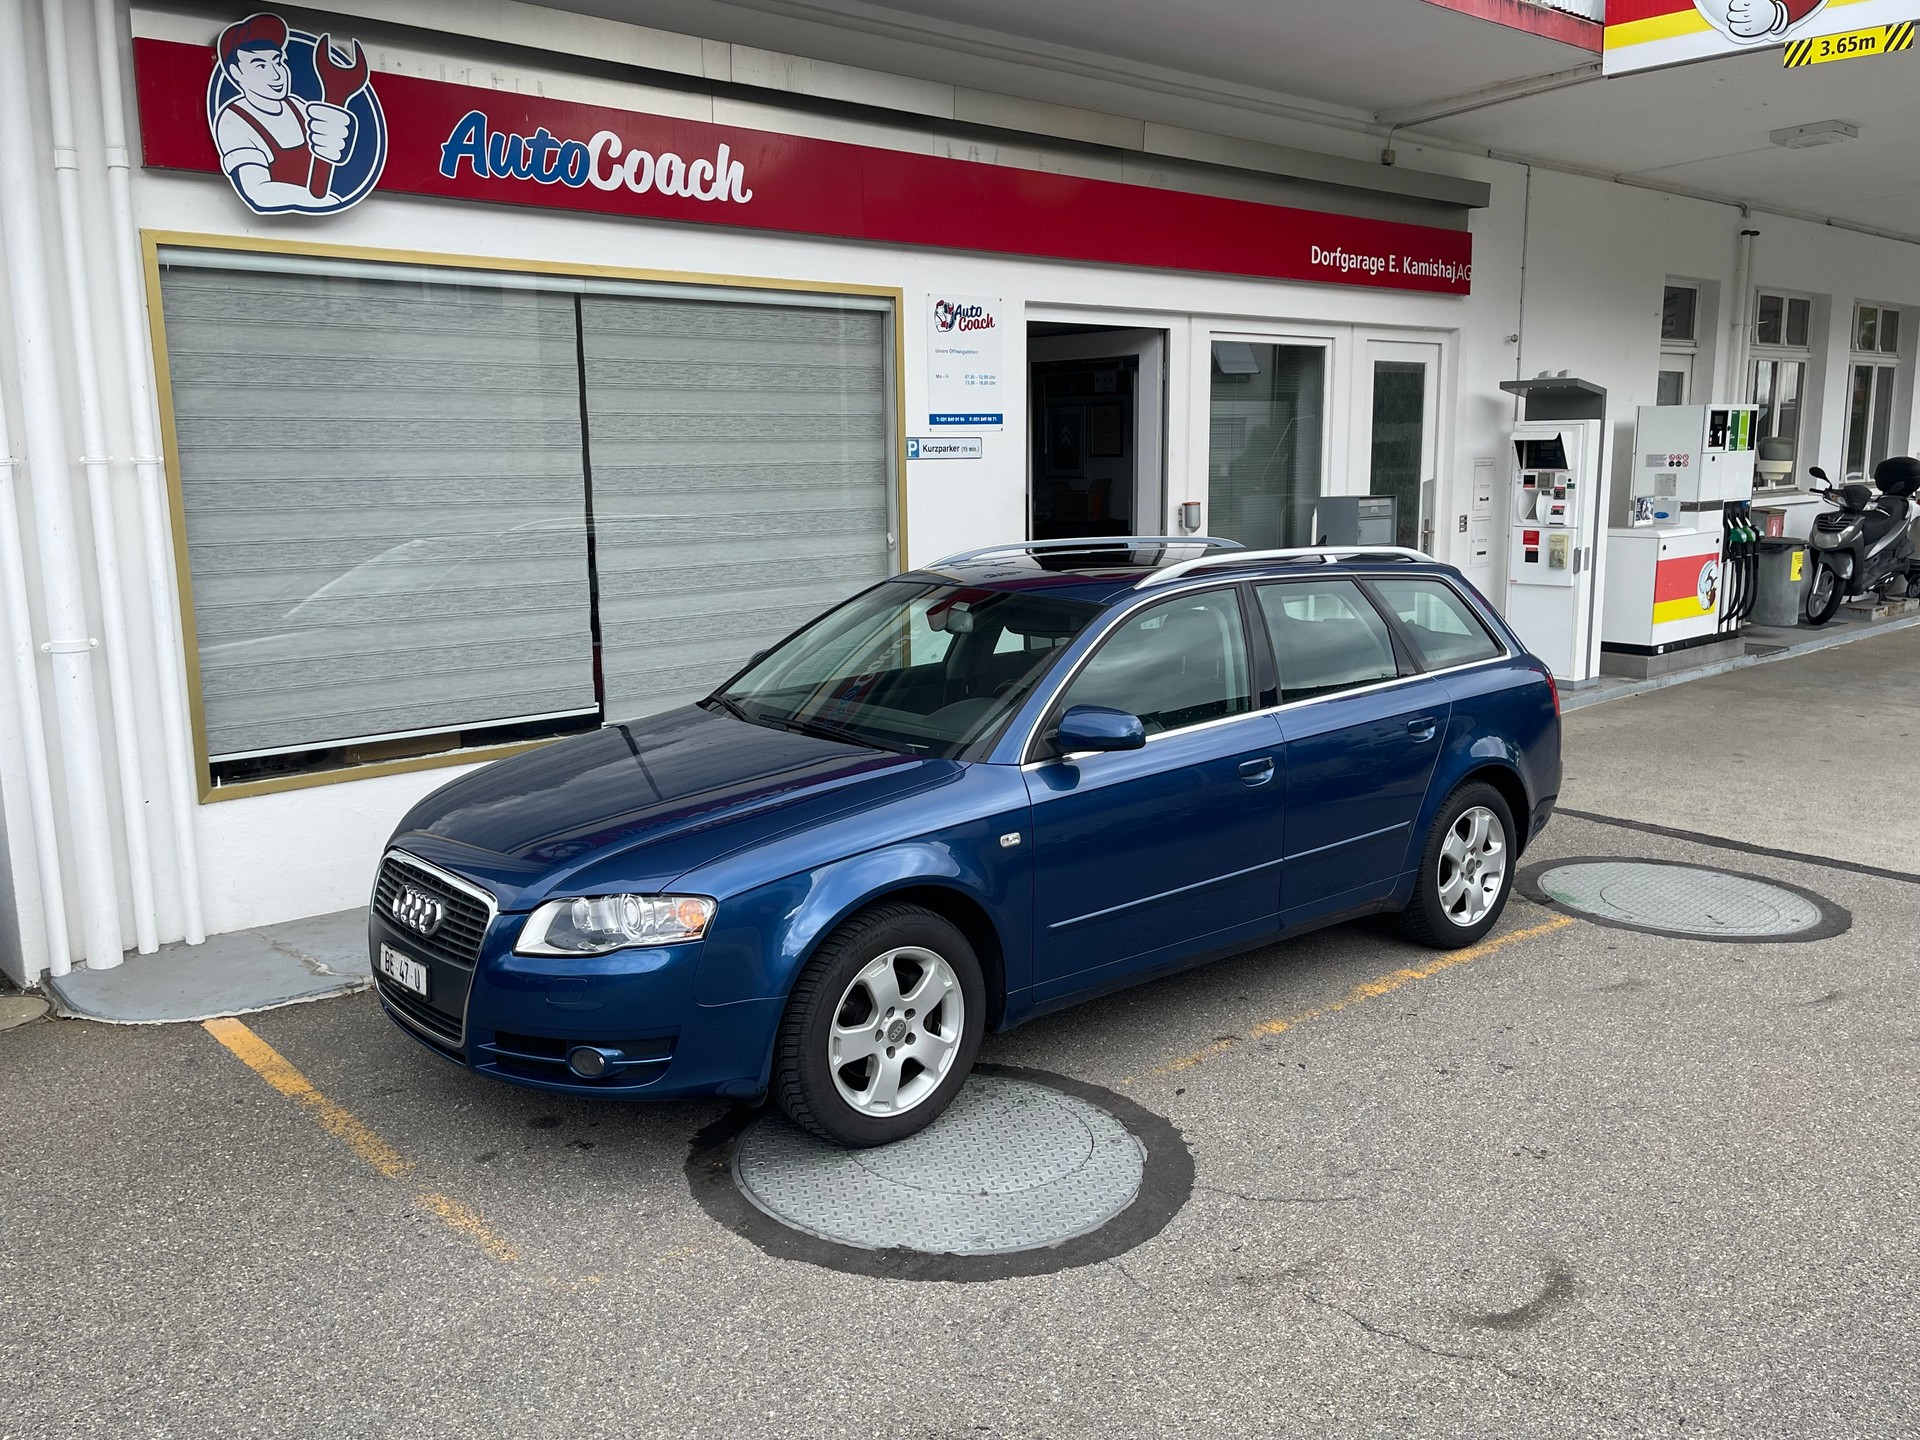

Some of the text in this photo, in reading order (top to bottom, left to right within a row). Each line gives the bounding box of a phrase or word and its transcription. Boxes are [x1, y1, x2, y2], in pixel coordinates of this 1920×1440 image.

[1819, 35, 1876, 57] 3.65m
[439, 110, 753, 203] AutoCoach
[1311, 245, 1385, 276] Dorfgarage
[1389, 254, 1399, 273] E.
[1403, 256, 1456, 283] Kamishaj
[954, 304, 982, 321] Auto
[958, 313, 995, 332] Coach
[1717, 430, 1723, 444] 1
[908, 441, 917, 456] P
[922, 445, 960, 454] Kurzparker
[385, 951, 394, 975] BE
